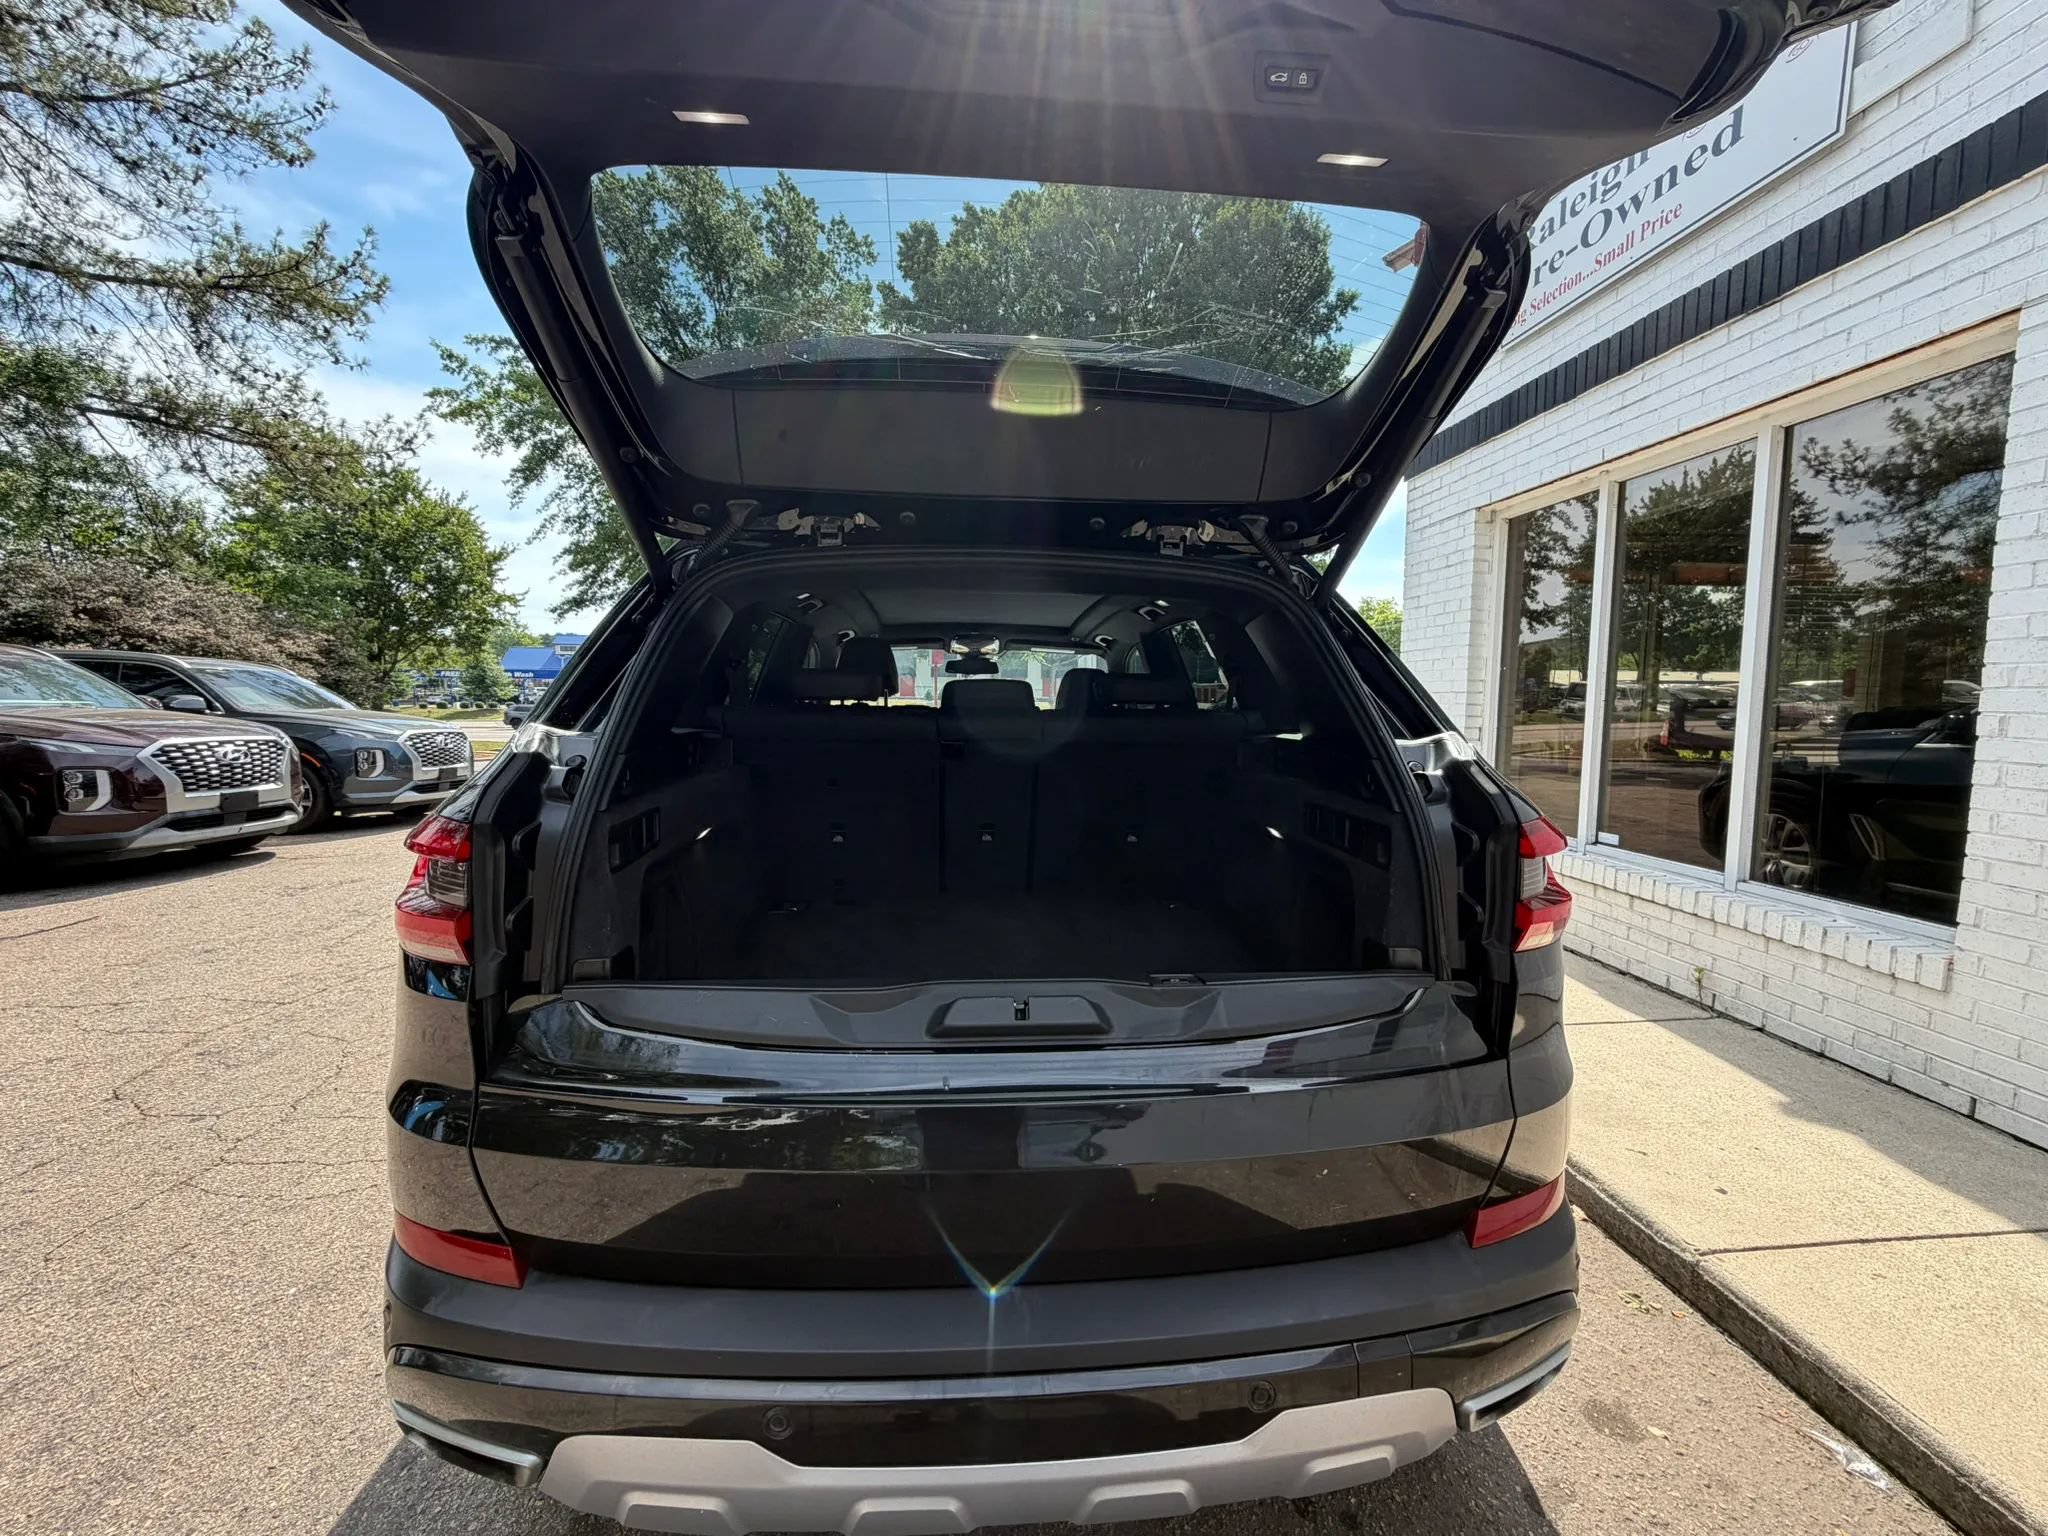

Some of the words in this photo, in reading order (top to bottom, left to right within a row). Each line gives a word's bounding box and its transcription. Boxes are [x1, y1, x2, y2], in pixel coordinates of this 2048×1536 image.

[1511, 308, 1528, 328] ig
[1638, 202, 1683, 243] Price
[1531, 103, 1745, 288] re-Owned
